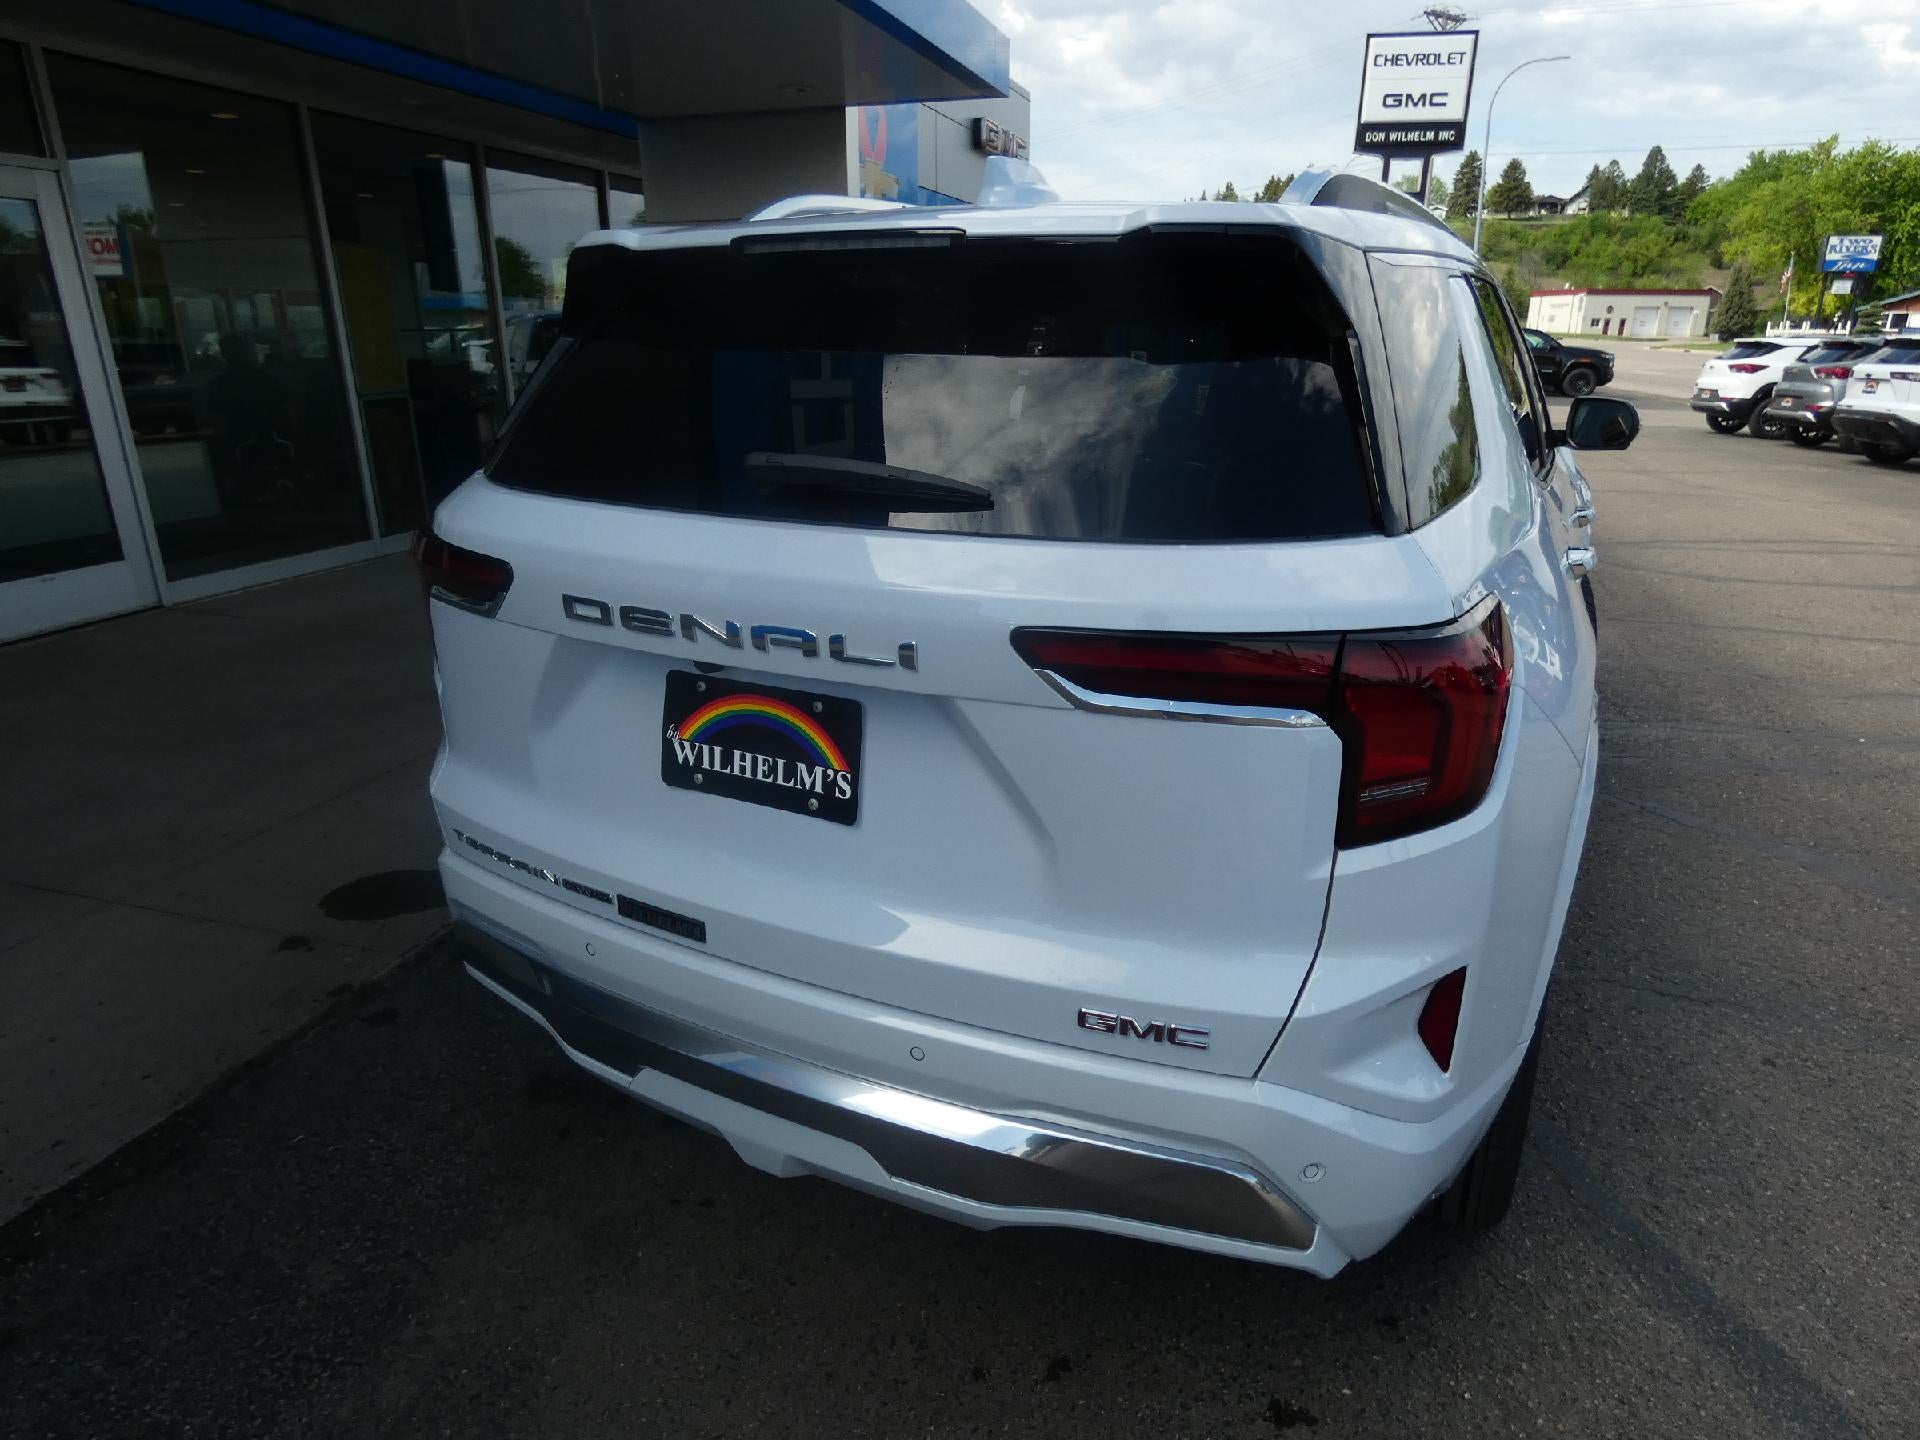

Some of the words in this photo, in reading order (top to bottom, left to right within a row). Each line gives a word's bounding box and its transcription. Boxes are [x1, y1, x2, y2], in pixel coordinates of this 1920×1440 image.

[1373, 52, 1467, 67] CHEVROLET
[1382, 92, 1448, 109] GMC
[1365, 131, 1386, 143] DON
[1389, 130, 1435, 142] WILHELM
[1438, 130, 1456, 141] INC
[562, 593, 919, 672] DENALI
[672, 739, 852, 800] WILHELM'S
[1078, 1007, 1210, 1050] GMC
